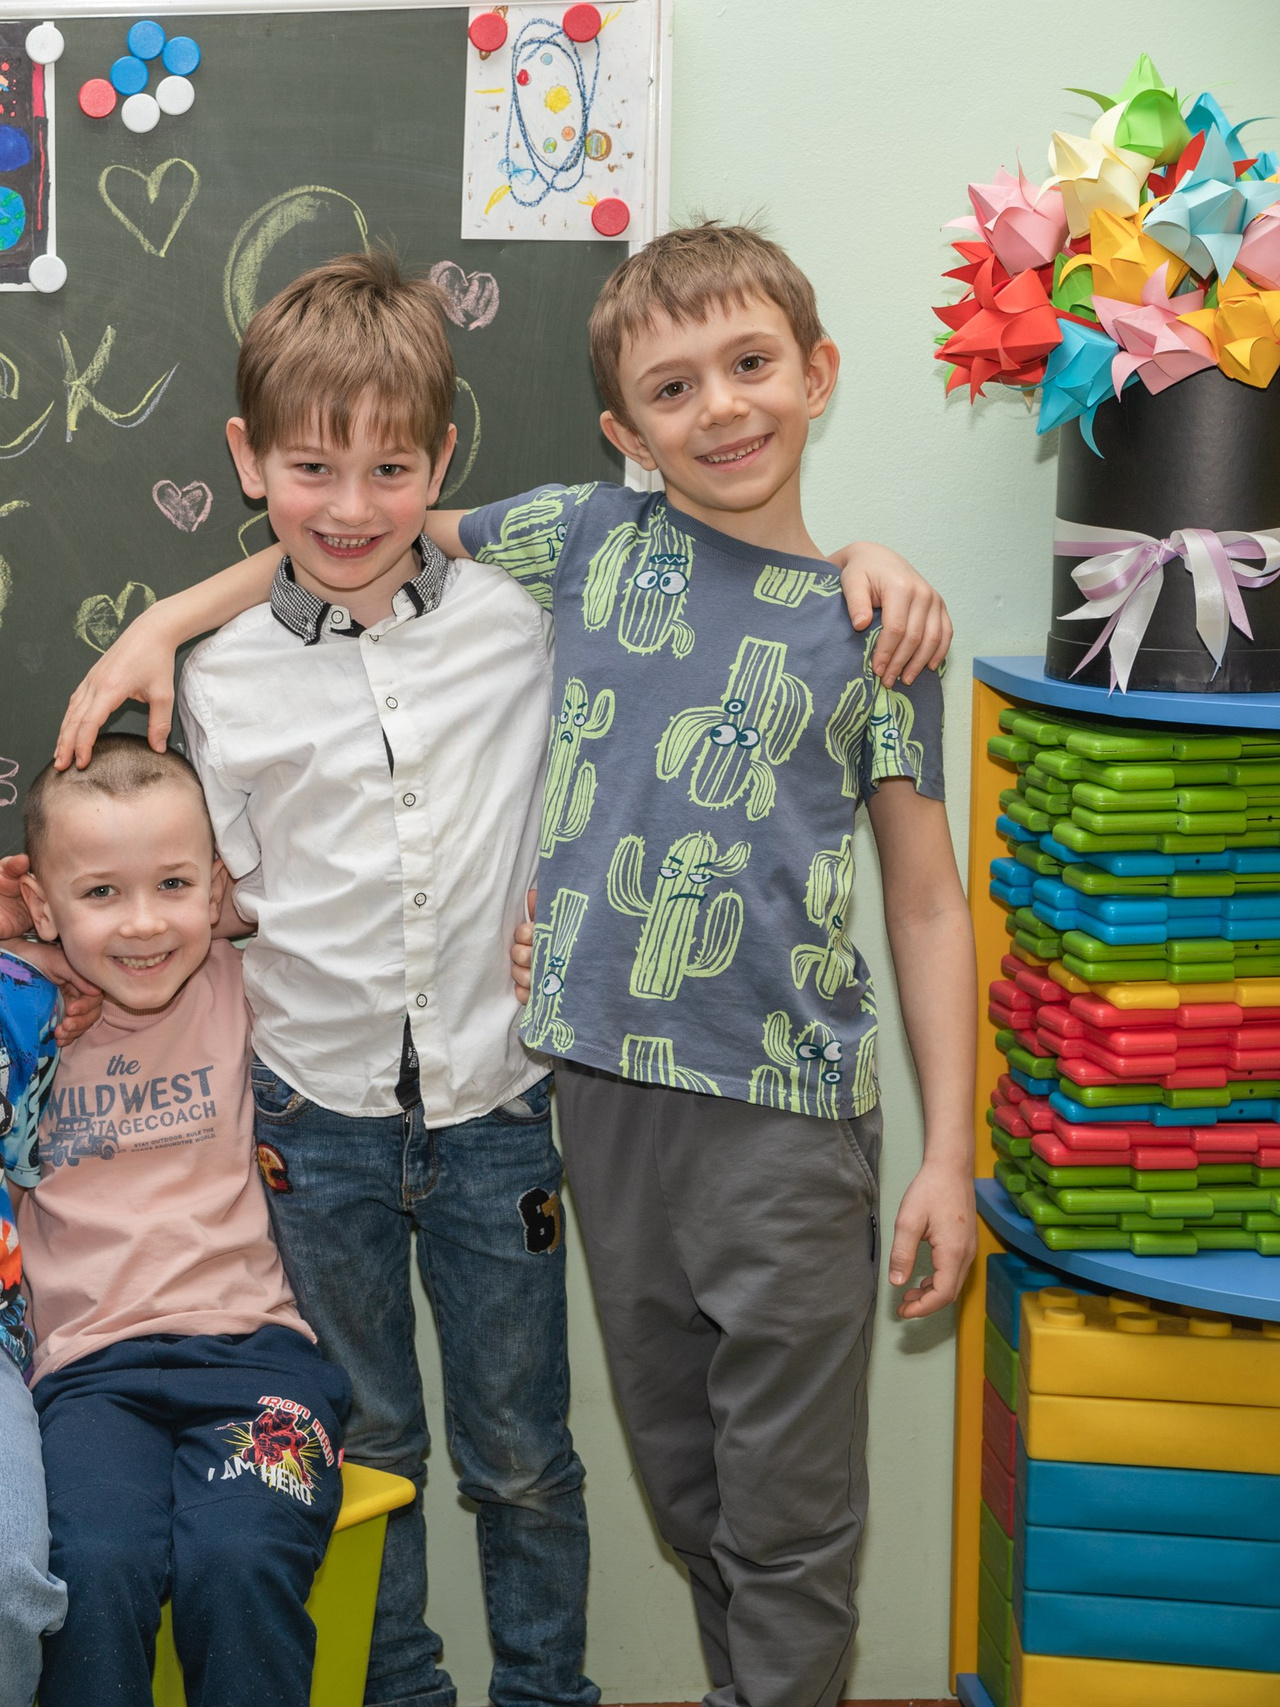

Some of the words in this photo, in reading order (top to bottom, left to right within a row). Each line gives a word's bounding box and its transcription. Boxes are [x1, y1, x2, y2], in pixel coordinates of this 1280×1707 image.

[106, 1054, 140, 1077] the
[89, 1100, 217, 1138] STAGECOACH
[257, 1395, 311, 1420] IRON
[311, 1418, 335, 1468] MAN
[207, 1467, 216, 1482] I
[221, 1456, 257, 1480] AM
[261, 1461, 312, 1506] HERO
